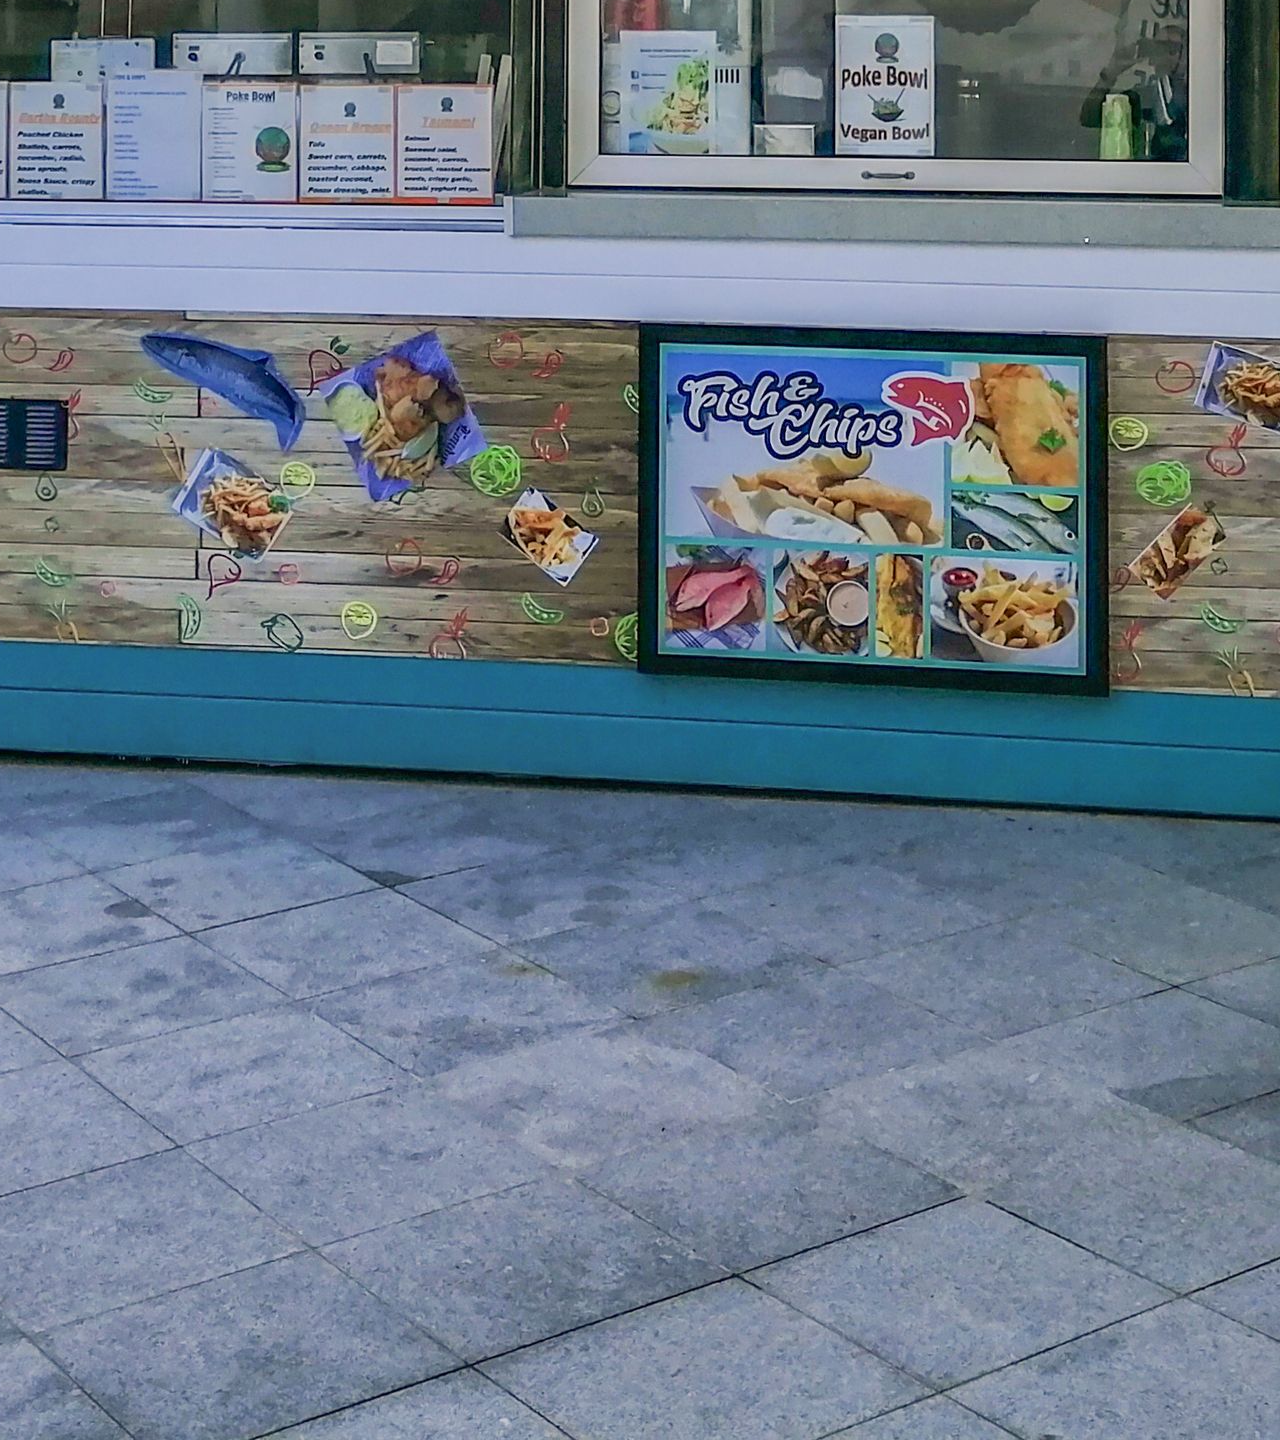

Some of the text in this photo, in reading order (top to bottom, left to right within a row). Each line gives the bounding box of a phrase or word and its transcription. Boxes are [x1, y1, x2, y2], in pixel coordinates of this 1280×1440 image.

[841, 64, 928, 91] Poke Bowl
[226, 91, 276, 103] Poke Bowl
[840, 122, 930, 143] Vegan Bowl
[17, 143, 50, 151] Shallots,
[308, 140, 326, 148] Tofu
[356, 153, 387, 161] carrots,
[351, 165, 387, 173] cabbage,
[71, 178, 96, 187] crispy
[371, 186, 391, 194] mint.
[682, 374, 901, 457] Fish & Chips
